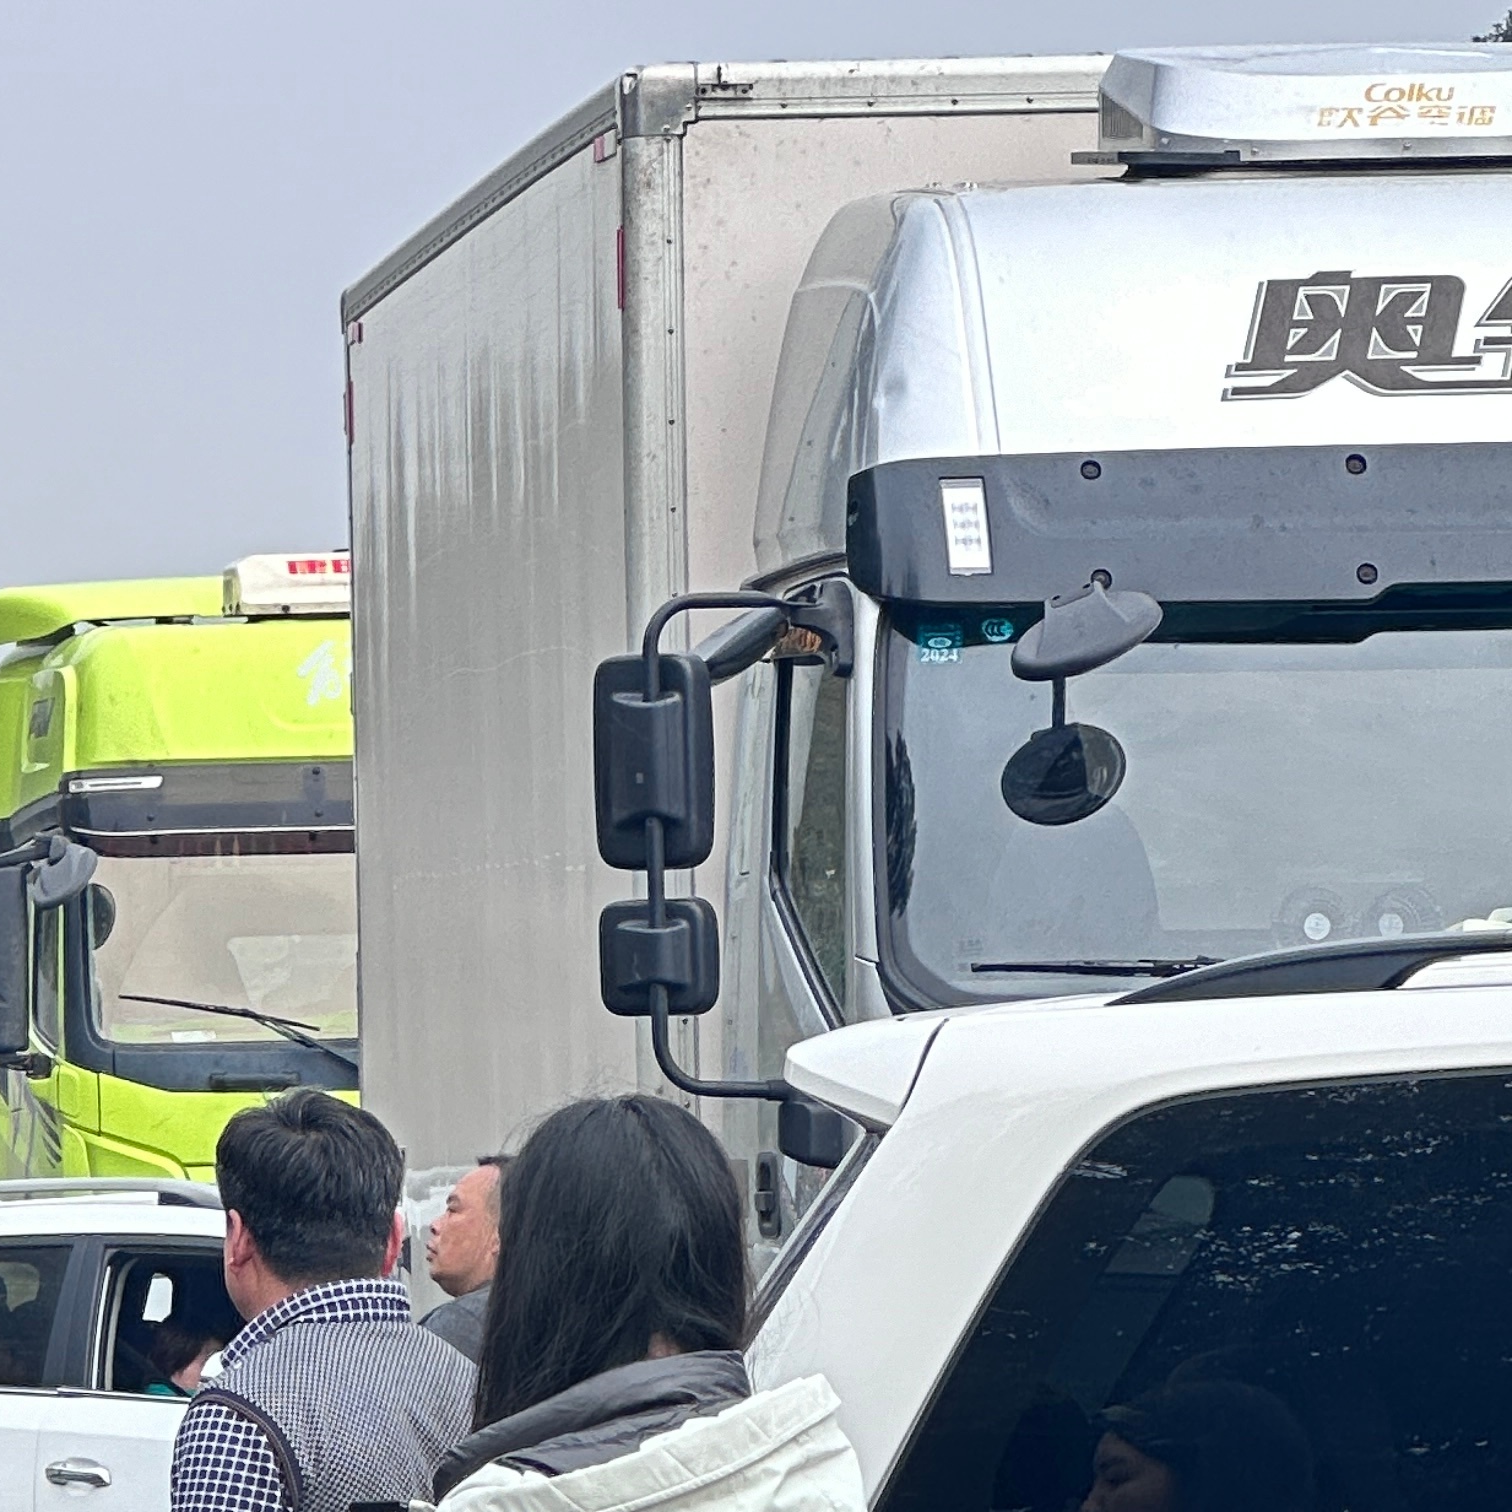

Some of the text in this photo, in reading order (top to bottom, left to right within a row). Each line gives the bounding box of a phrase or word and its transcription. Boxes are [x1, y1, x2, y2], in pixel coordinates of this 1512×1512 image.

[1364, 83, 1455, 102] Colku
[1221, 269, 1512, 402] 奥
[920, 648, 959, 663] 2024
